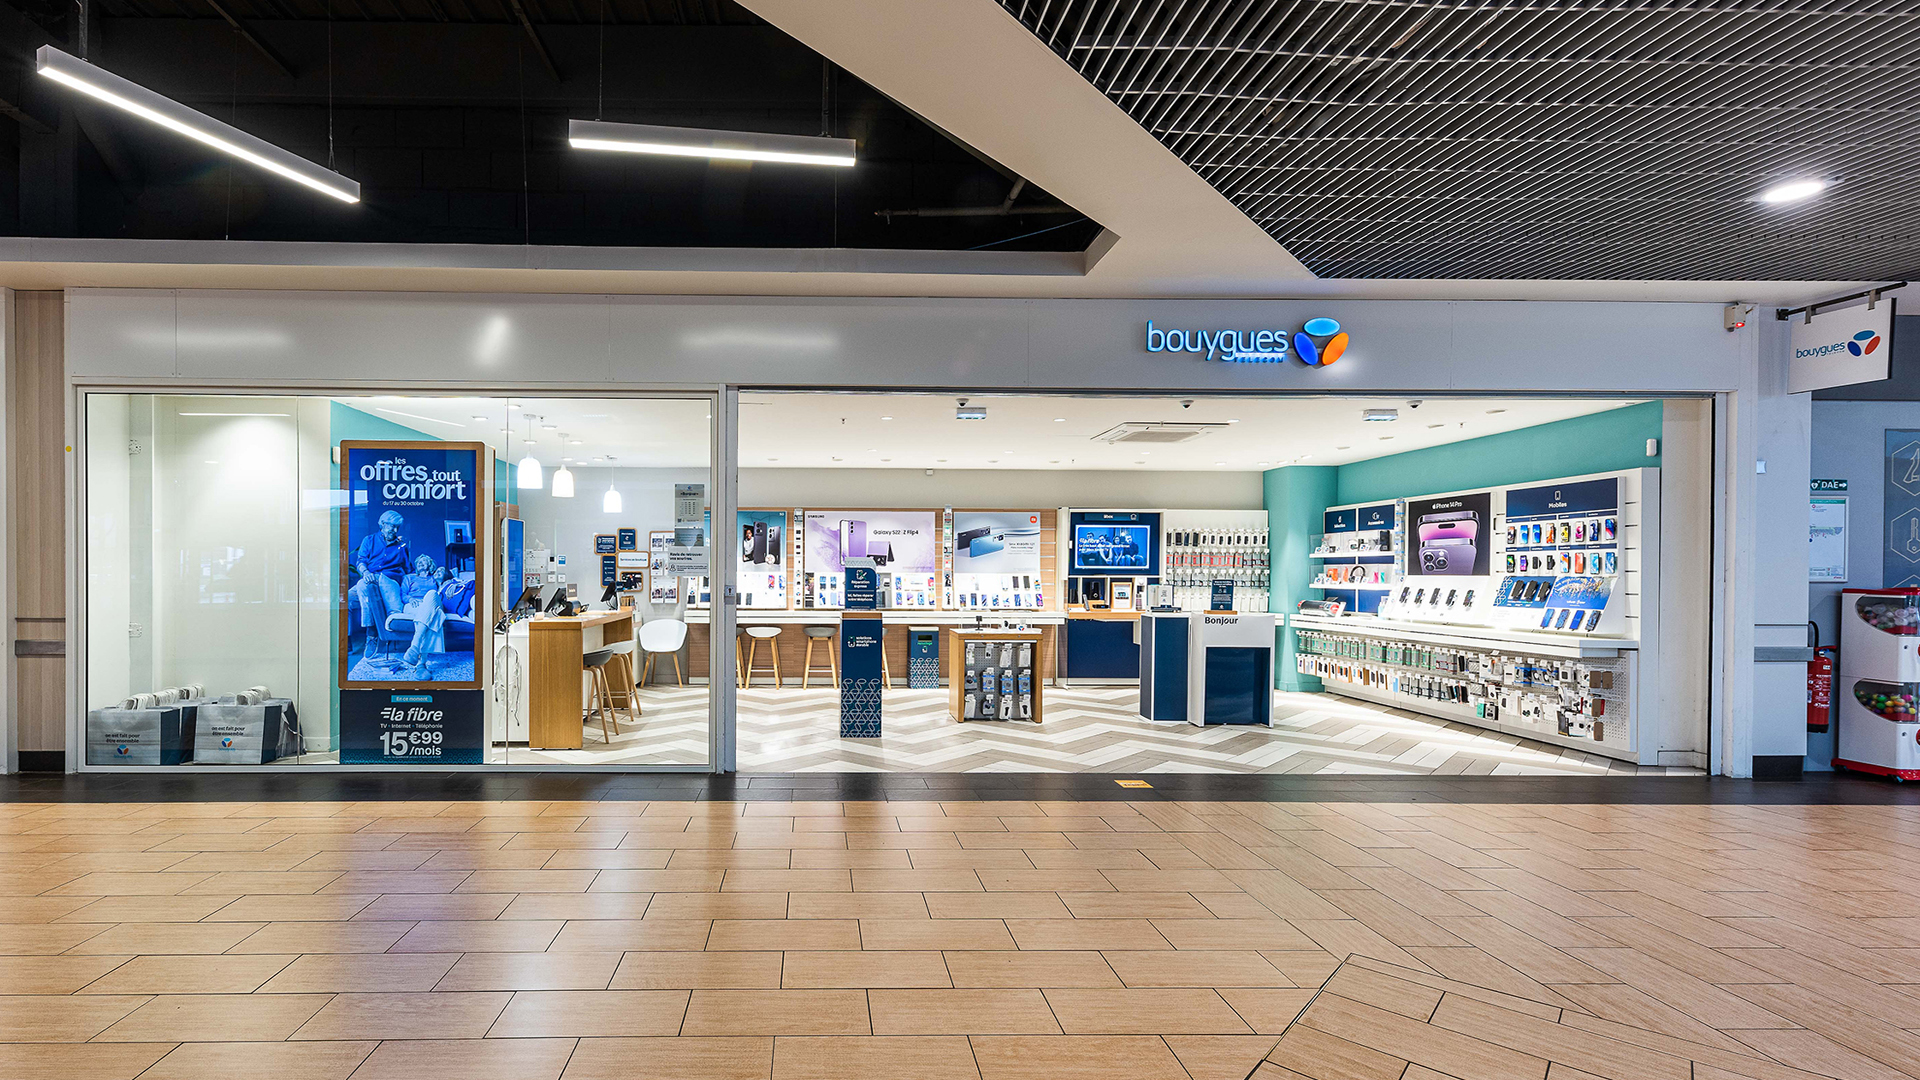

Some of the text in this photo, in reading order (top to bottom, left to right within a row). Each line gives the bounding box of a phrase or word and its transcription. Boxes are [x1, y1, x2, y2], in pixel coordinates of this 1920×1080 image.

[1146, 320, 1290, 361] bouygues
[1796, 342, 1846, 359] bouygues
[360, 460, 462, 482] offres tout
[382, 479, 467, 500] confort
[1821, 481, 1839, 489] DAE
[1204, 616, 1239, 626] Bonjour
[390, 707, 443, 721] la fibre
[409, 745, 442, 756] /mois
